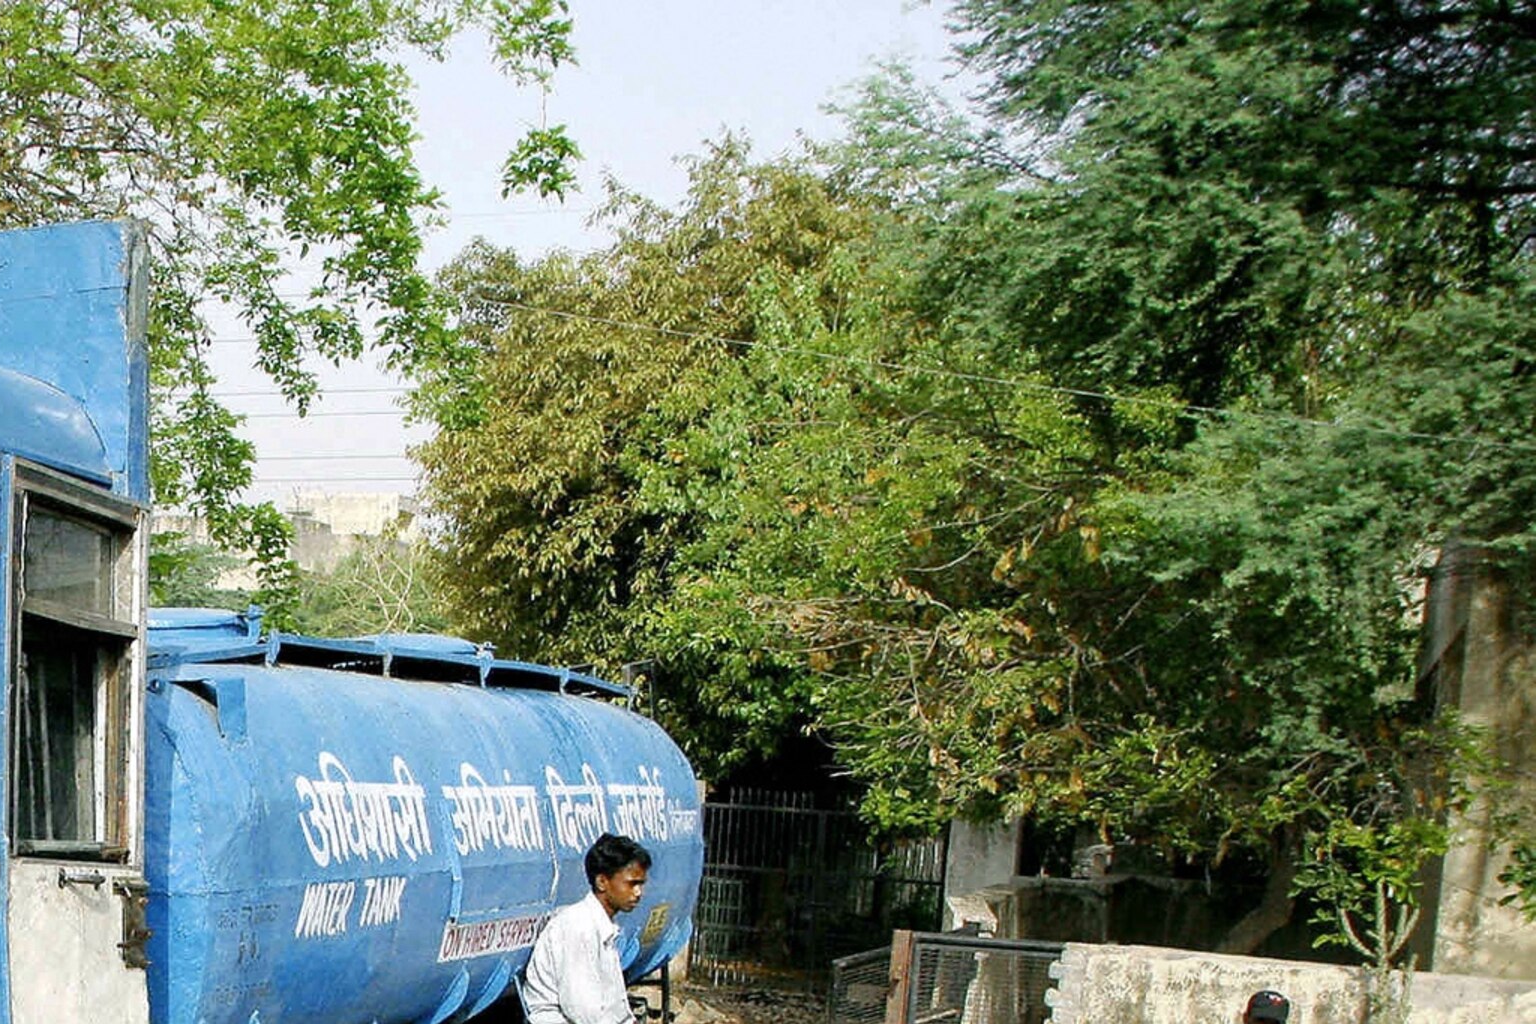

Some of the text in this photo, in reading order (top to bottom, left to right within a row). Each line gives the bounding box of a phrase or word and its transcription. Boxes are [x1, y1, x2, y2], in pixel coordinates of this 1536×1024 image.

[545, 762, 609, 853] दिल्ली
[295, 881, 355, 938] WATER
[360, 876, 406, 926] TANK
[443, 926, 461, 957] ON
